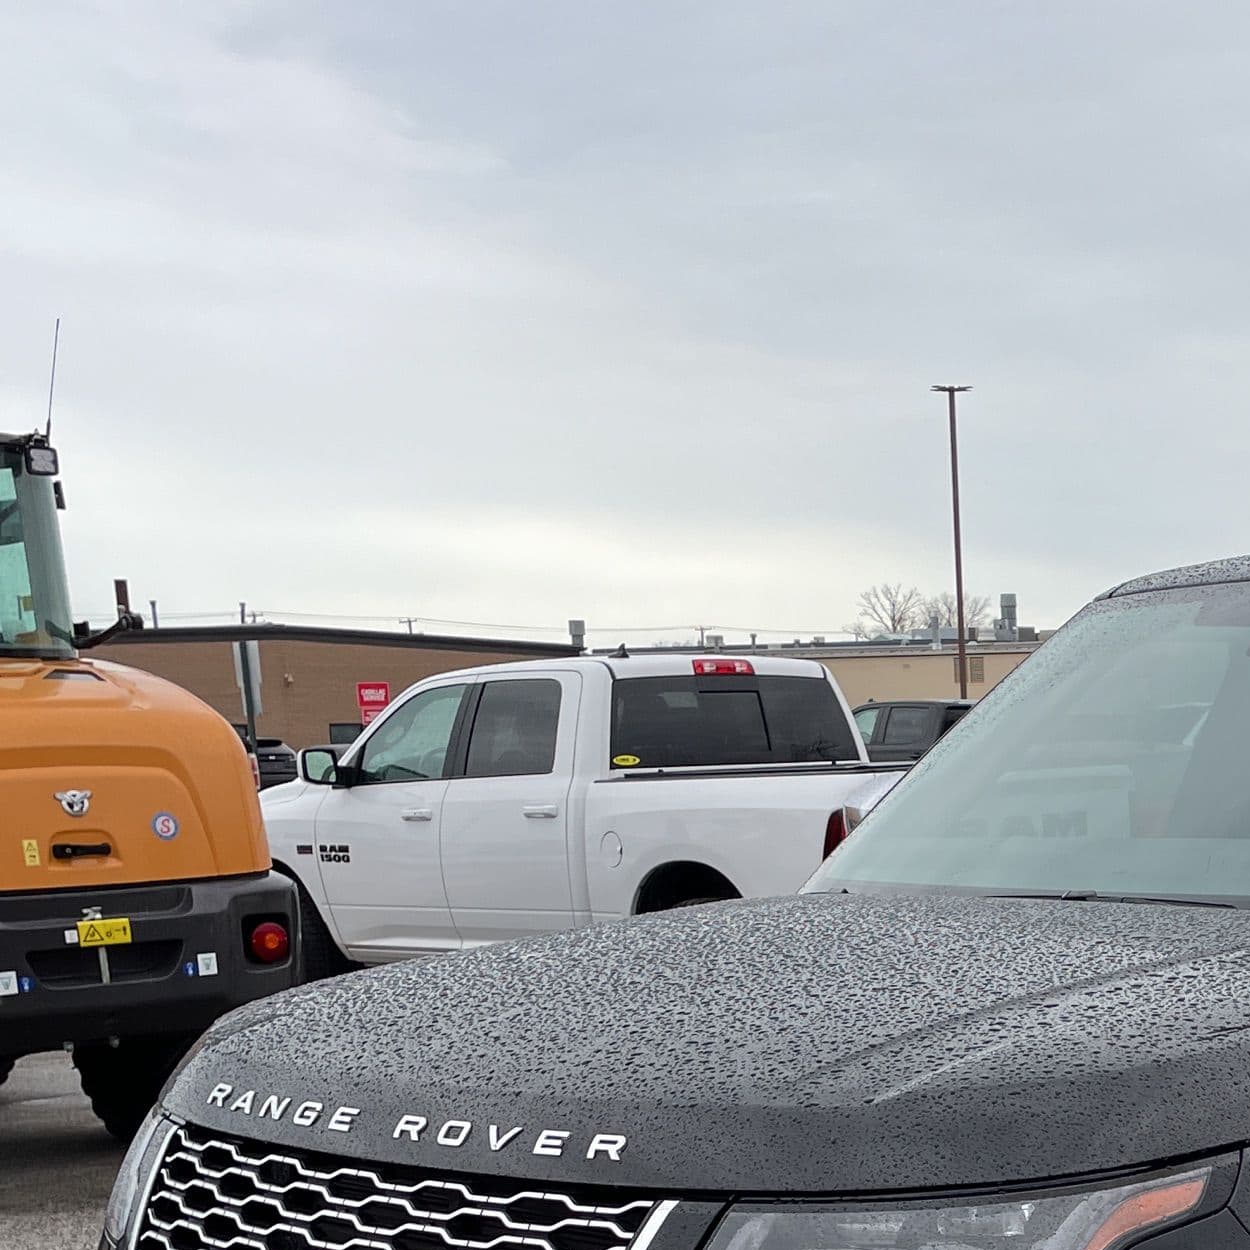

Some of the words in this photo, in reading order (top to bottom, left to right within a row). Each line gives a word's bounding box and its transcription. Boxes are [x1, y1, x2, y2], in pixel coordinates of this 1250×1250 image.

[319, 844, 350, 853] RAM
[320, 854, 351, 863] 1500
[206, 1083, 360, 1133] RANGE
[393, 1115, 627, 1161] ROVER
